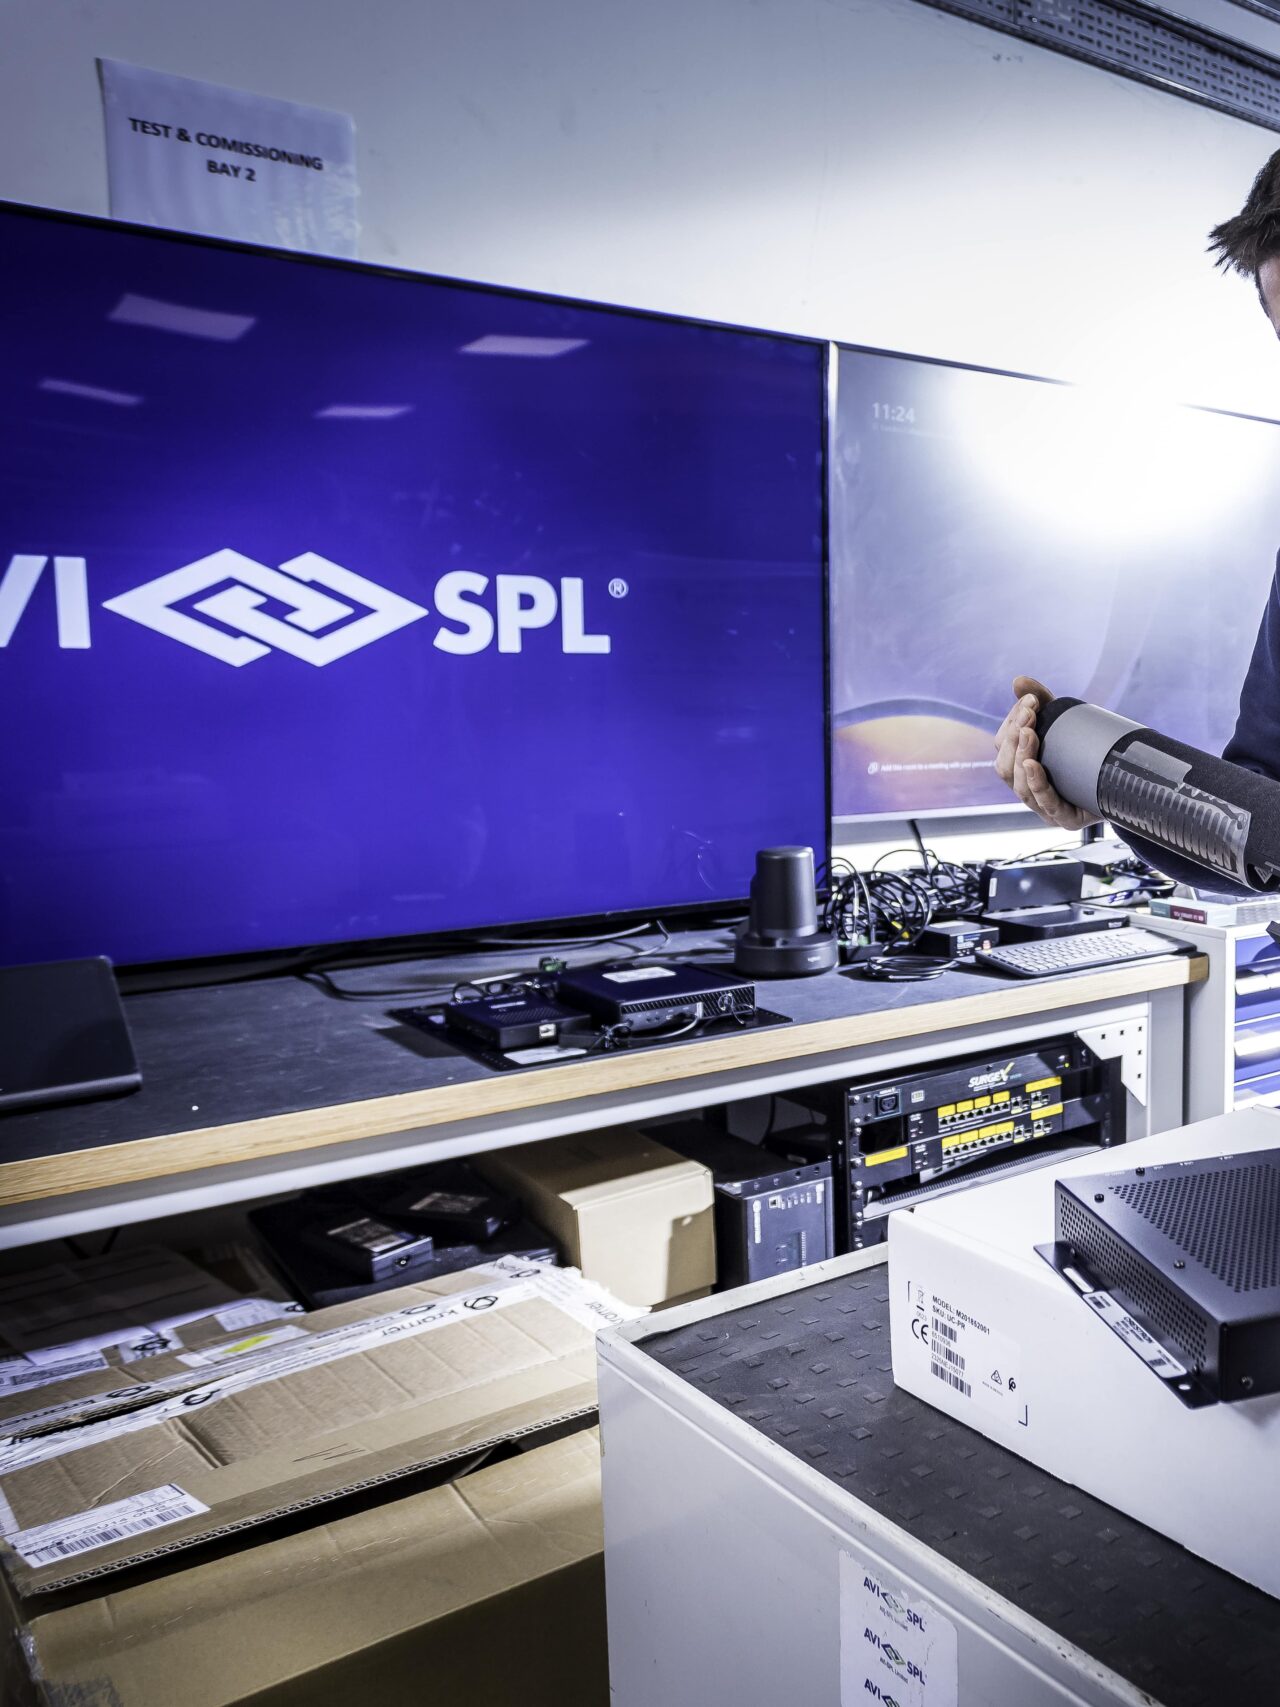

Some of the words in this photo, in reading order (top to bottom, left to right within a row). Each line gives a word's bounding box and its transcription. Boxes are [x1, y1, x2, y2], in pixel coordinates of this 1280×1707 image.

[128, 117, 172, 138] TEST
[176, 128, 192, 142] &
[195, 132, 324, 171] COMISSIONING
[206, 159, 241, 178] BAY
[245, 168, 256, 182] 2
[872, 402, 915, 423] 11:24
[932, 1295, 955, 1314] MODEL:
[382, 1309, 459, 1337] kramer
[932, 1305, 946, 1318] SKU:
[946, 1312, 966, 1332] UC-PR
[863, 1576, 880, 1598] AVI
[906, 1608, 926, 1633] SPL
[863, 1627, 881, 1649] AVI
[906, 1660, 926, 1686] SPL
[864, 1677, 881, 1701] AVI
